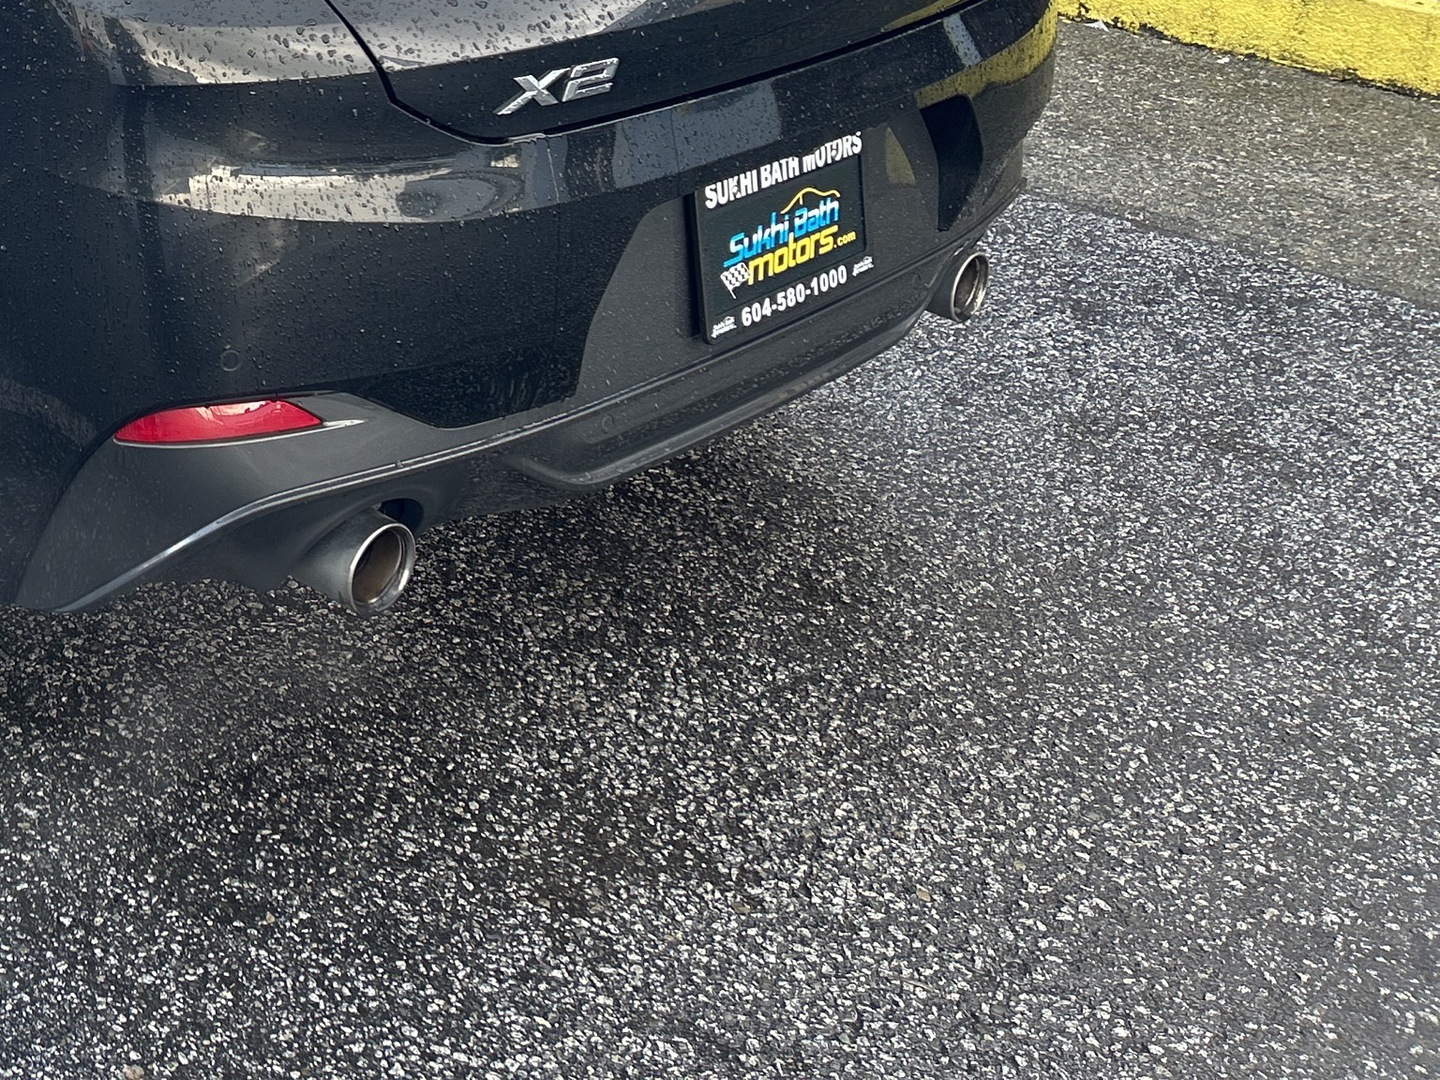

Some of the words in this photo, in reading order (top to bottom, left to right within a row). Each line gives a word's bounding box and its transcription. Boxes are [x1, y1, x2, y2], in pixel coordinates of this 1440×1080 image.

[493, 57, 620, 116] X2
[704, 168, 759, 209] SUKHI
[760, 155, 801, 189] BATH
[723, 212, 790, 268] Sukhi
[793, 197, 841, 238] Bath
[741, 264, 848, 327] 604-580-1000
